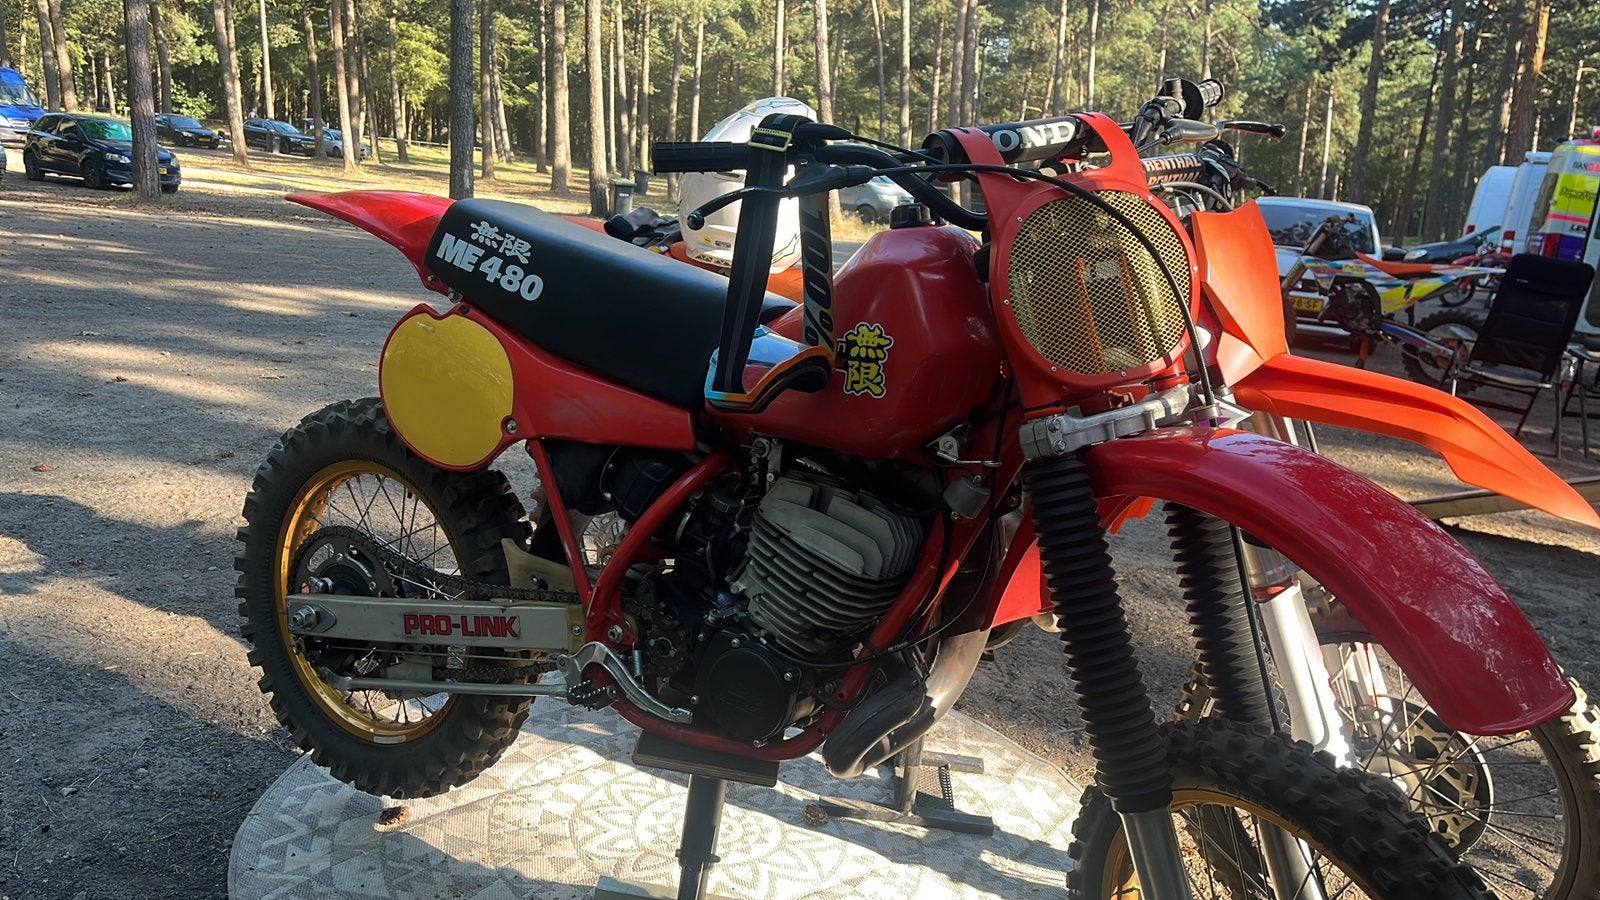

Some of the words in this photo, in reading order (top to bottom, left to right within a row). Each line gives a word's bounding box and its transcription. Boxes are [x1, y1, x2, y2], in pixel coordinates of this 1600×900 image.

[990, 121, 1079, 152] OND
[1142, 155, 1202, 172] RENTHAL
[470, 221, 532, 264] 無限
[436, 232, 486, 273] ME
[479, 255, 544, 301] 480
[801, 211, 834, 352] 100%
[846, 324, 891, 395] 無限
[403, 613, 519, 638] PRO-LINK
